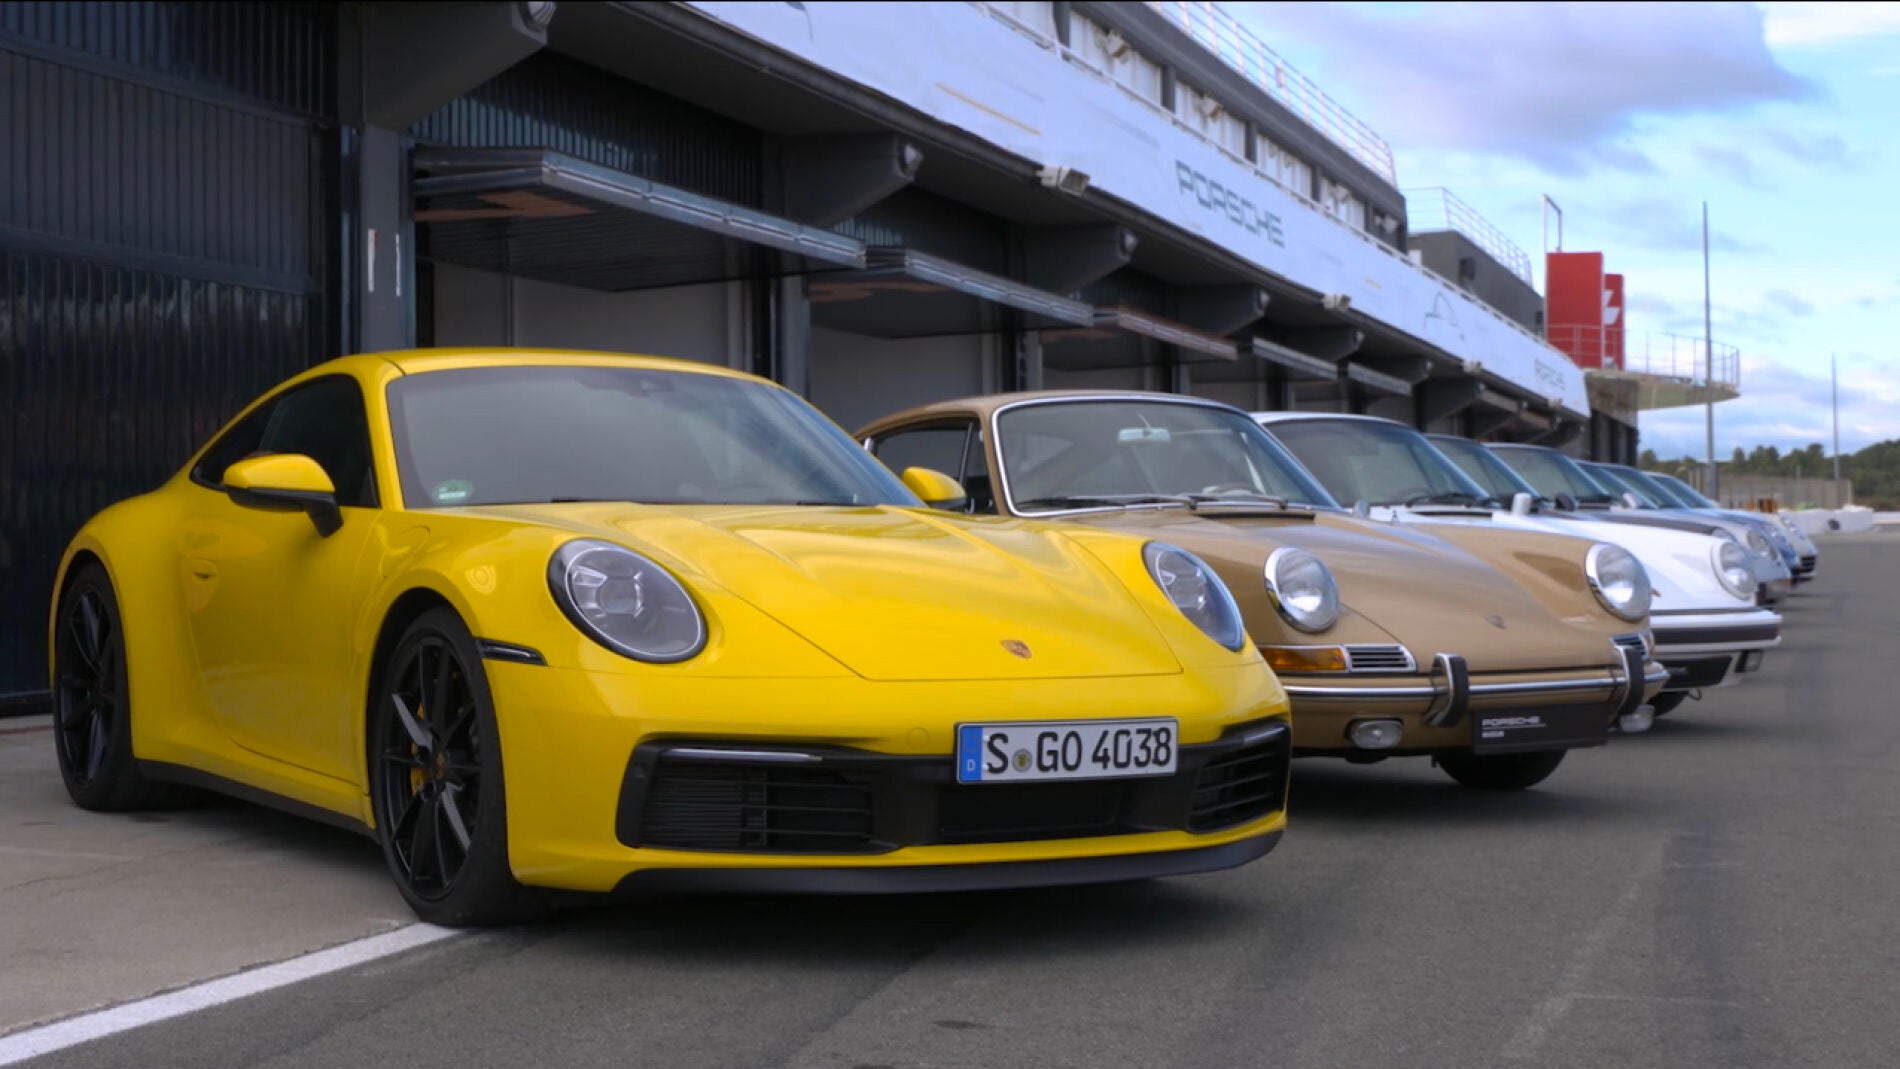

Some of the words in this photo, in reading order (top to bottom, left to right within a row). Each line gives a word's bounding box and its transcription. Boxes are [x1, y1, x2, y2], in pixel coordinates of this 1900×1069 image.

[1175, 160, 1285, 248] PORSCHE
[986, 732, 1009, 774] S
[1037, 730, 1083, 772] GO
[1092, 726, 1172, 769] 4038
